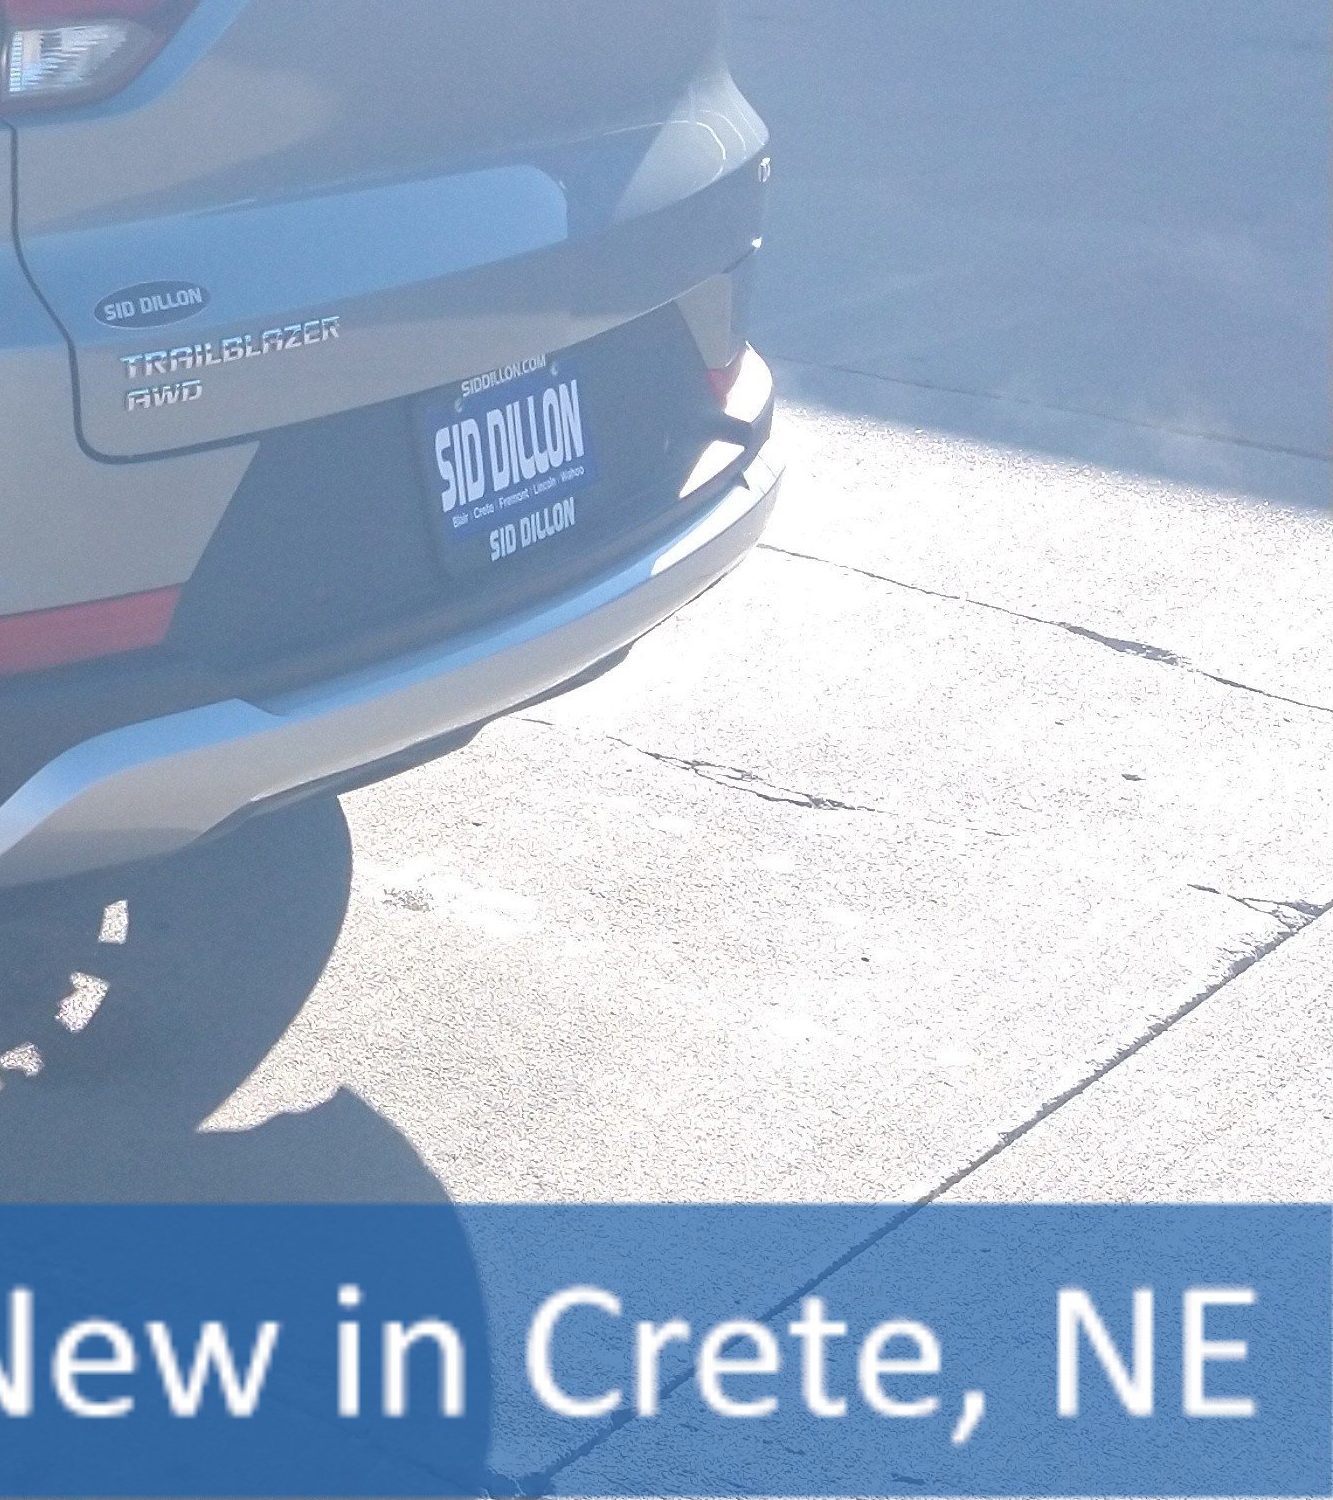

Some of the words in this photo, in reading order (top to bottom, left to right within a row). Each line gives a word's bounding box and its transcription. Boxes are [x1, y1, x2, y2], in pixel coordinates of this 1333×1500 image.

[103, 300, 135, 321] SID
[139, 287, 203, 314] DILLON
[119, 315, 341, 379] TRAILBLAZER
[125, 379, 203, 412] AWD
[460, 353, 547, 398] SIDDILLON.COM
[435, 418, 485, 513] SID
[486, 379, 585, 492] DILLON
[473, 502, 495, 519] Crete
[498, 488, 530, 509] Fremont
[489, 523, 517, 562] SID
[520, 496, 576, 548] DILLON
